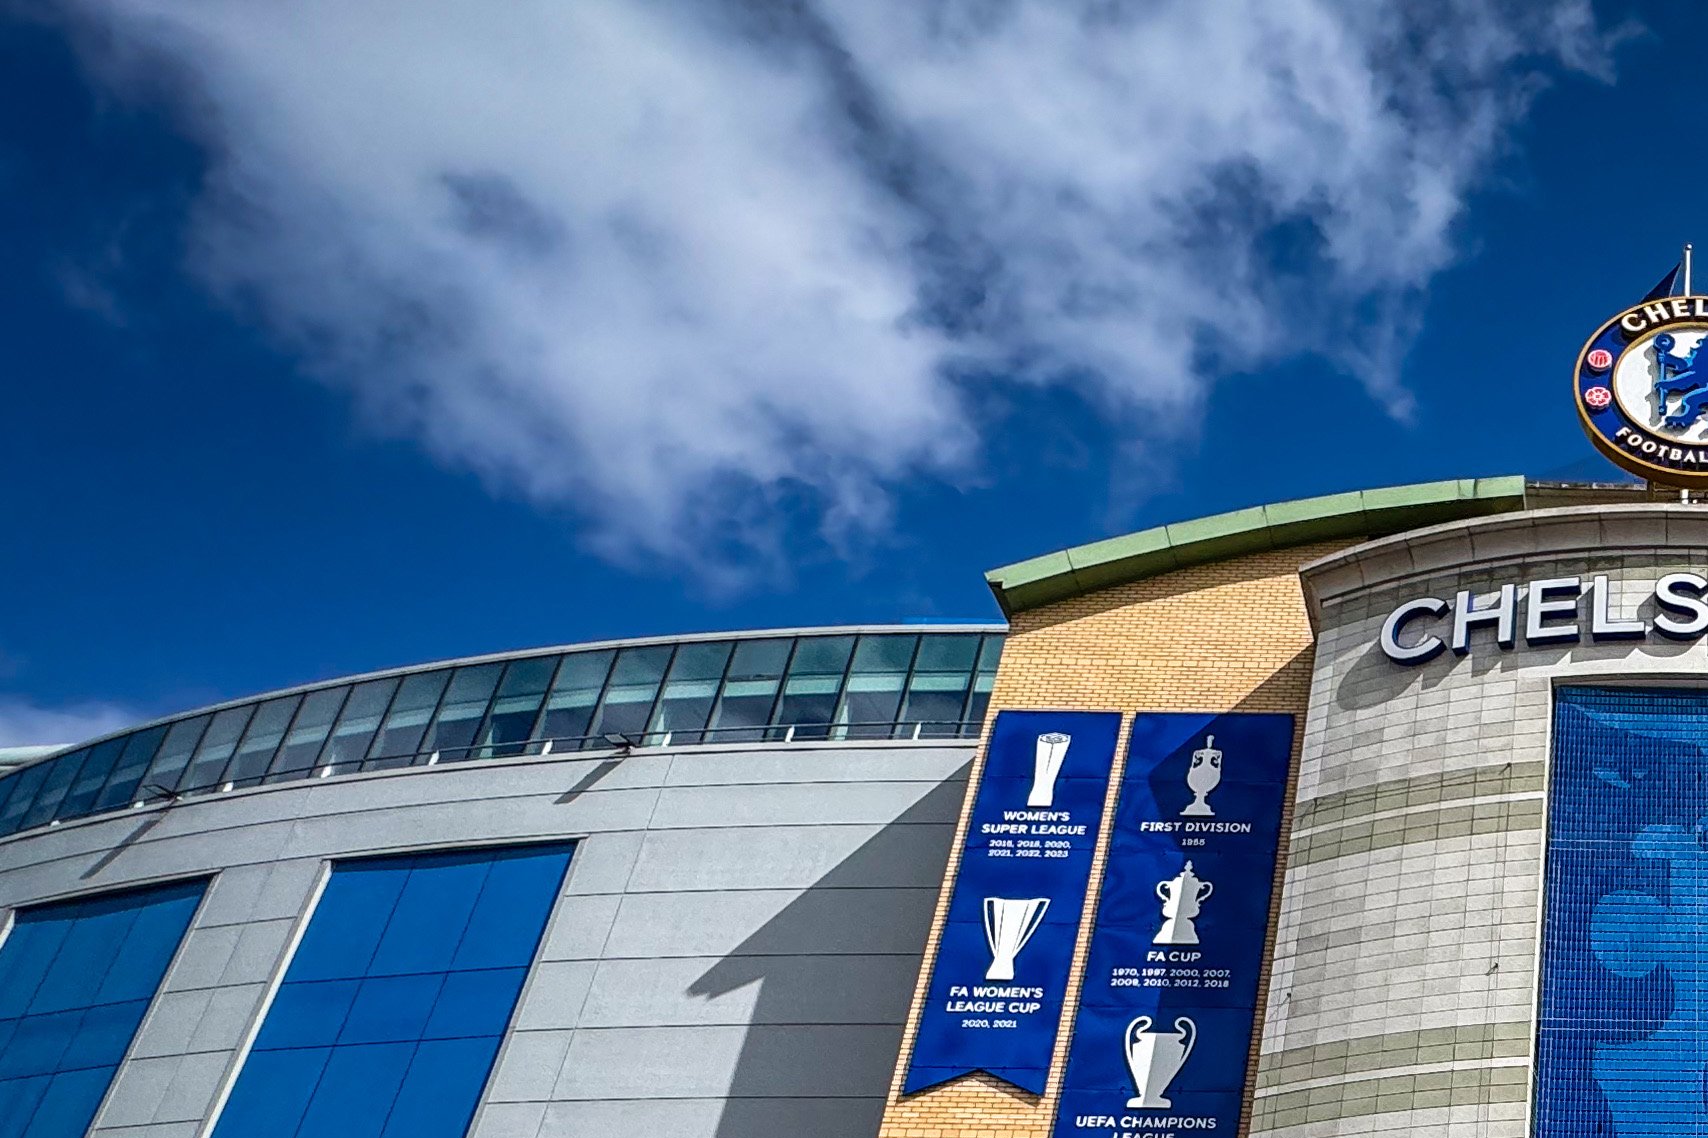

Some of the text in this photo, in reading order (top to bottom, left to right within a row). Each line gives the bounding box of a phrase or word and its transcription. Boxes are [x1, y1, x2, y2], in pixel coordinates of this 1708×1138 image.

[1004, 811, 1070, 821] WOMEN'S
[981, 824, 1087, 836] SUPER LEAGUE
[1140, 822, 1252, 833] FIRST DIVISION
[1147, 952, 1202, 962] FA CUP
[1112, 968, 1140, 977] 1970,
[1170, 969, 1201, 977] 2000,
[1143, 979, 1172, 987] 2010,
[950, 986, 1044, 999] FA WOMEN'S
[946, 1001, 1041, 1014] LEAGUE CUP
[962, 1019, 1017, 1029] 2020, 2021
[1076, 1116, 1217, 1129] UEFA CHAMPIONS
